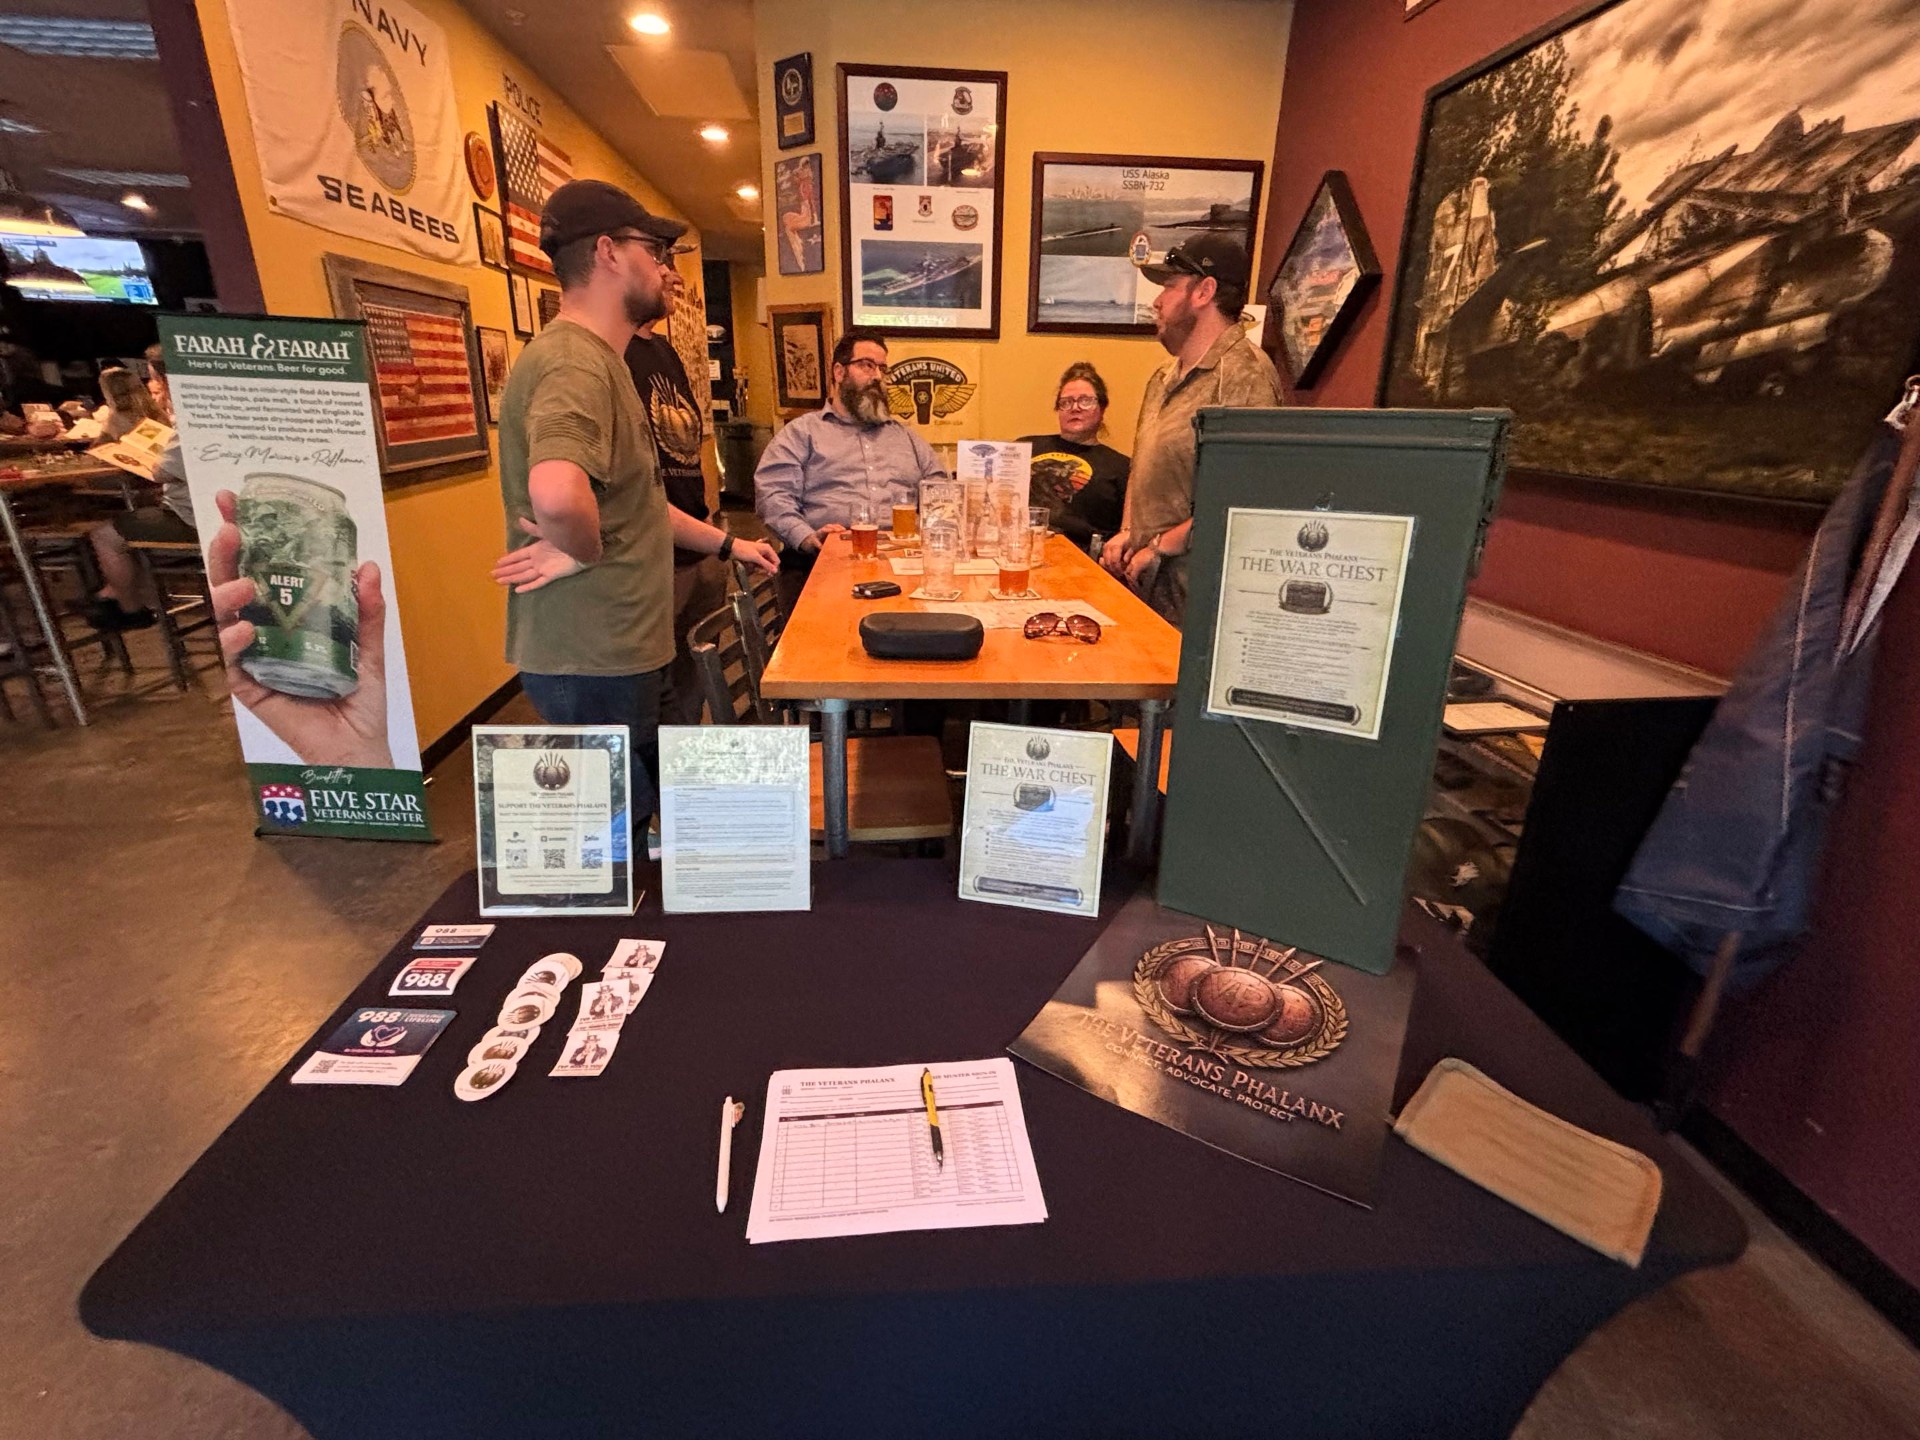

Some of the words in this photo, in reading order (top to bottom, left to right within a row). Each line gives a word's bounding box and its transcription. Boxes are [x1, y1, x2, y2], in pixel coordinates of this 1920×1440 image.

[353, 0, 427, 66] NAVY
[503, 73, 542, 127] POLICE
[1122, 169, 1140, 178] USS
[1142, 170, 1170, 179] Alaska
[1122, 180, 1164, 191] SSBN-732
[317, 174, 460, 244] SEABEES
[340, 330, 354, 338] JAX
[174, 334, 246, 355] FARAH
[251, 333, 275, 360] &
[277, 339, 350, 360] FARAH
[188, 360, 212, 369] Here
[214, 360, 228, 370] for
[230, 362, 276, 372] Veterans.
[278, 363, 300, 372] Beer
[302, 364, 316, 373] for
[319, 366, 348, 376] good.
[930, 363, 962, 382] UNITED
[200, 394, 228, 402] English
[335, 419, 361, 427] Fuggle
[1270, 548, 1284, 556] THE
[1286, 550, 1322, 559] VETERANS
[1324, 552, 1358, 562] PHALANX
[1240, 556, 1274, 572] THE
[1280, 559, 1320, 577] WAR
[1326, 564, 1388, 582] CHEST
[270, 574, 304, 589] ALERT
[280, 588, 293, 606] 5
[980, 762, 1008, 776] THE
[1013, 766, 1046, 780] WAR
[1050, 770, 1096, 786] CHEST
[310, 789, 360, 808] FIVE
[364, 792, 422, 812] STAR
[313, 808, 374, 820] VETERANS
[376, 810, 424, 823] CENTER
[404, 973, 446, 988] 988
[358, 1010, 402, 1023] 988
[1120, 1016, 1227, 1083] VETERANS
[1234, 1071, 1344, 1130] PHALANX
[1236, 1093, 1297, 1123] PROTECT
